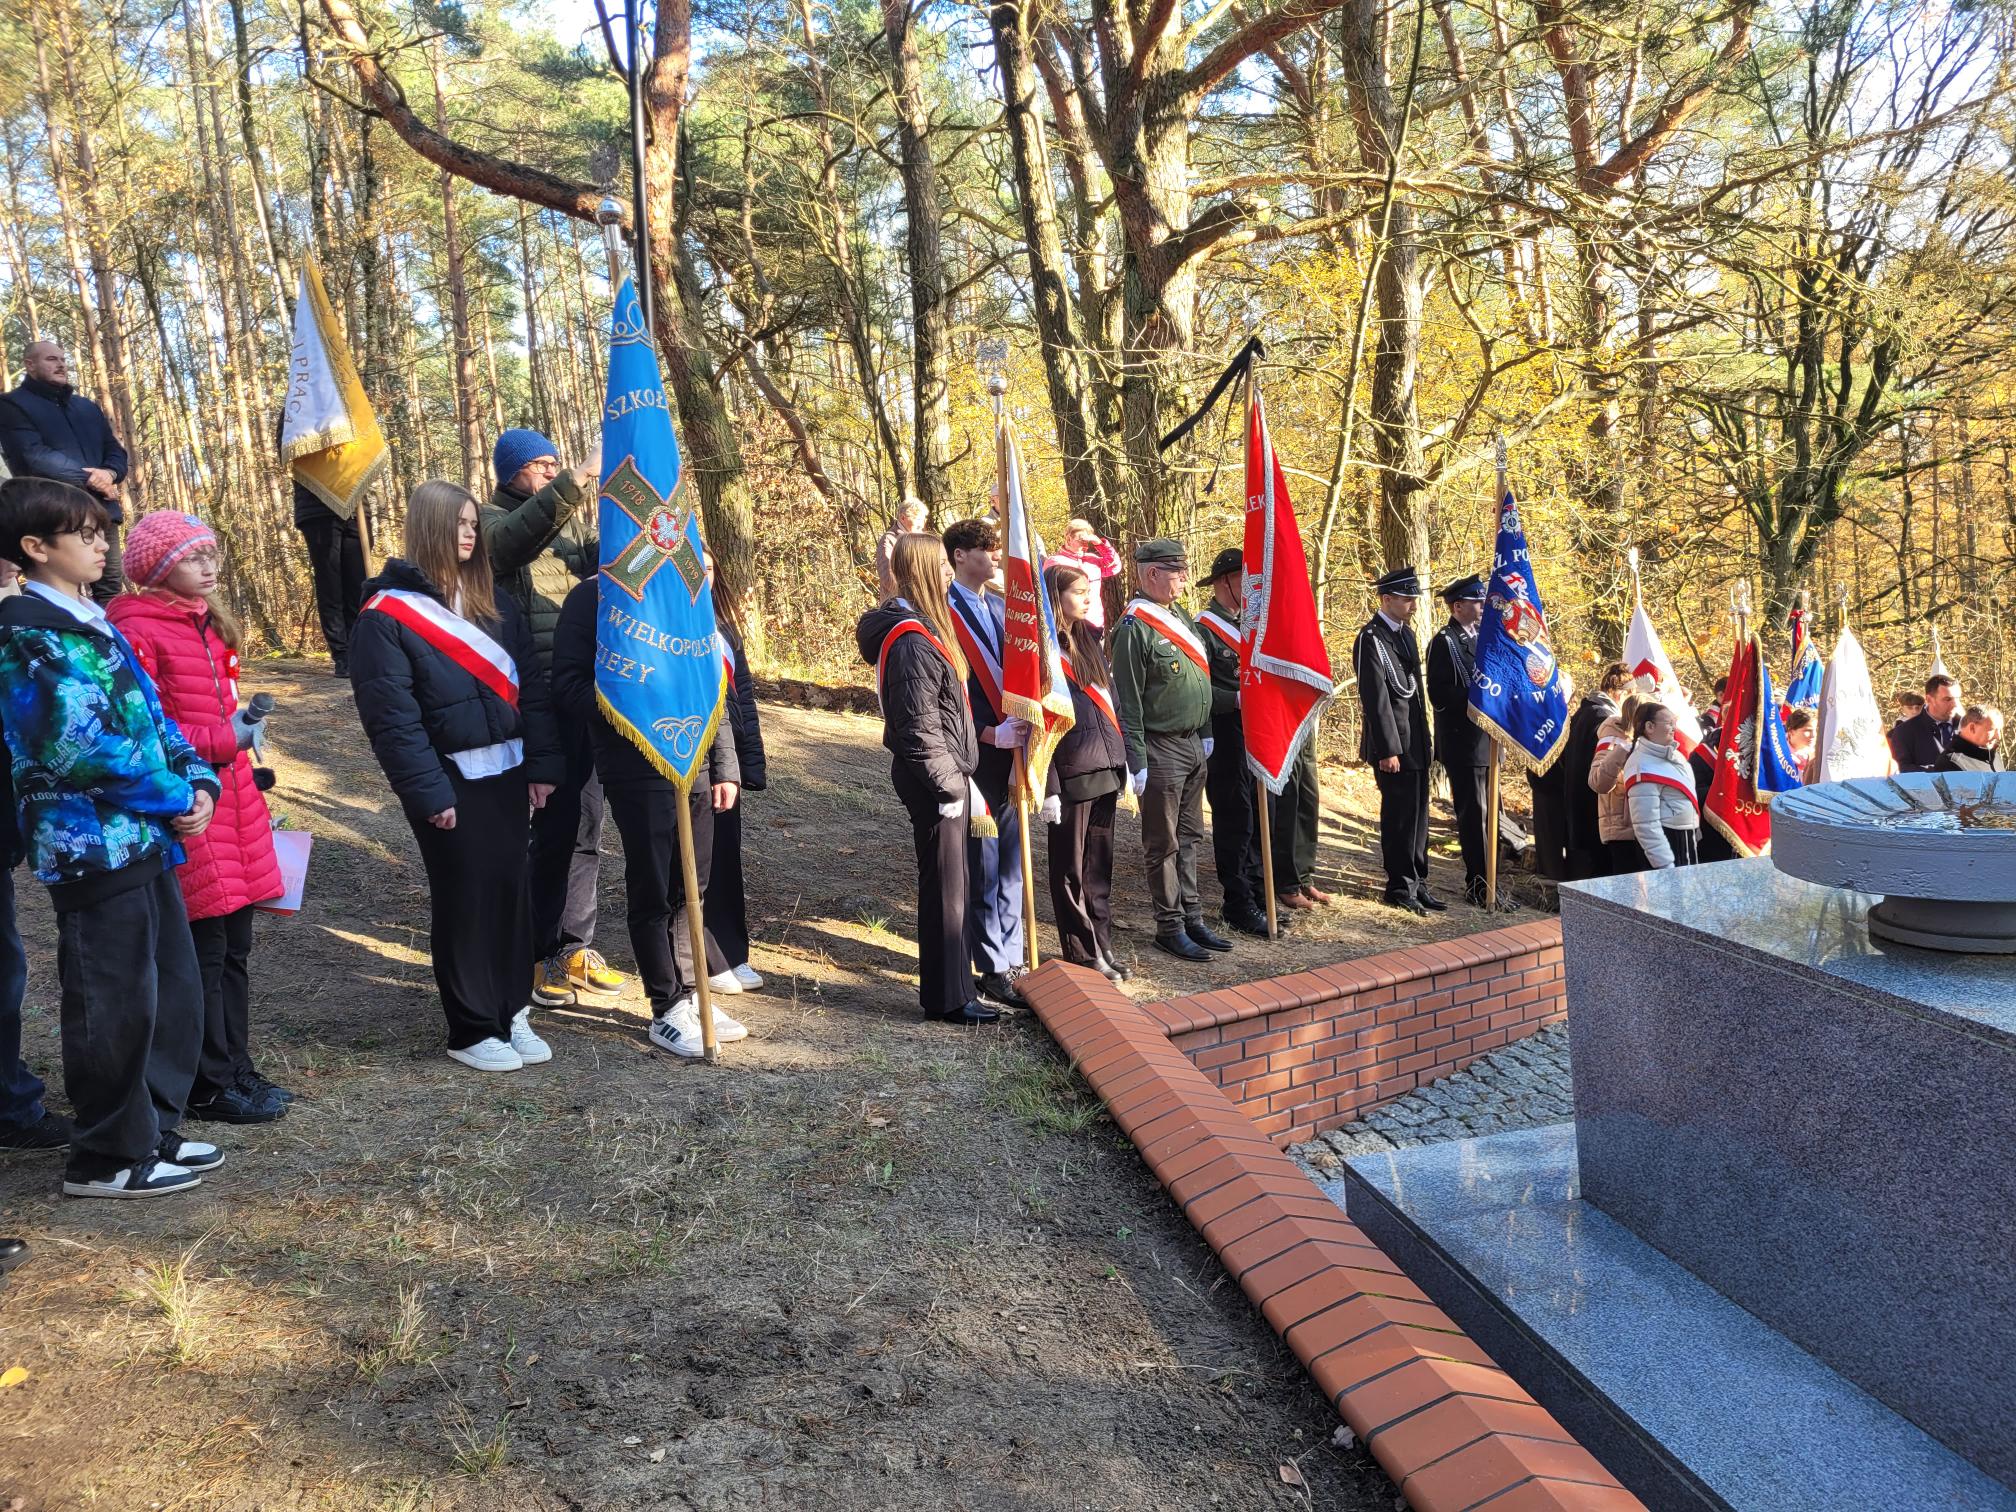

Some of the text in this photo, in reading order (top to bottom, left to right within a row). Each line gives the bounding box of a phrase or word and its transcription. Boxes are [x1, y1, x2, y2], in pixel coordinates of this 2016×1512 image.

[620, 479, 646, 506] 1918
[684, 558, 699, 580] 1919
[1534, 718, 1556, 743] 1920
